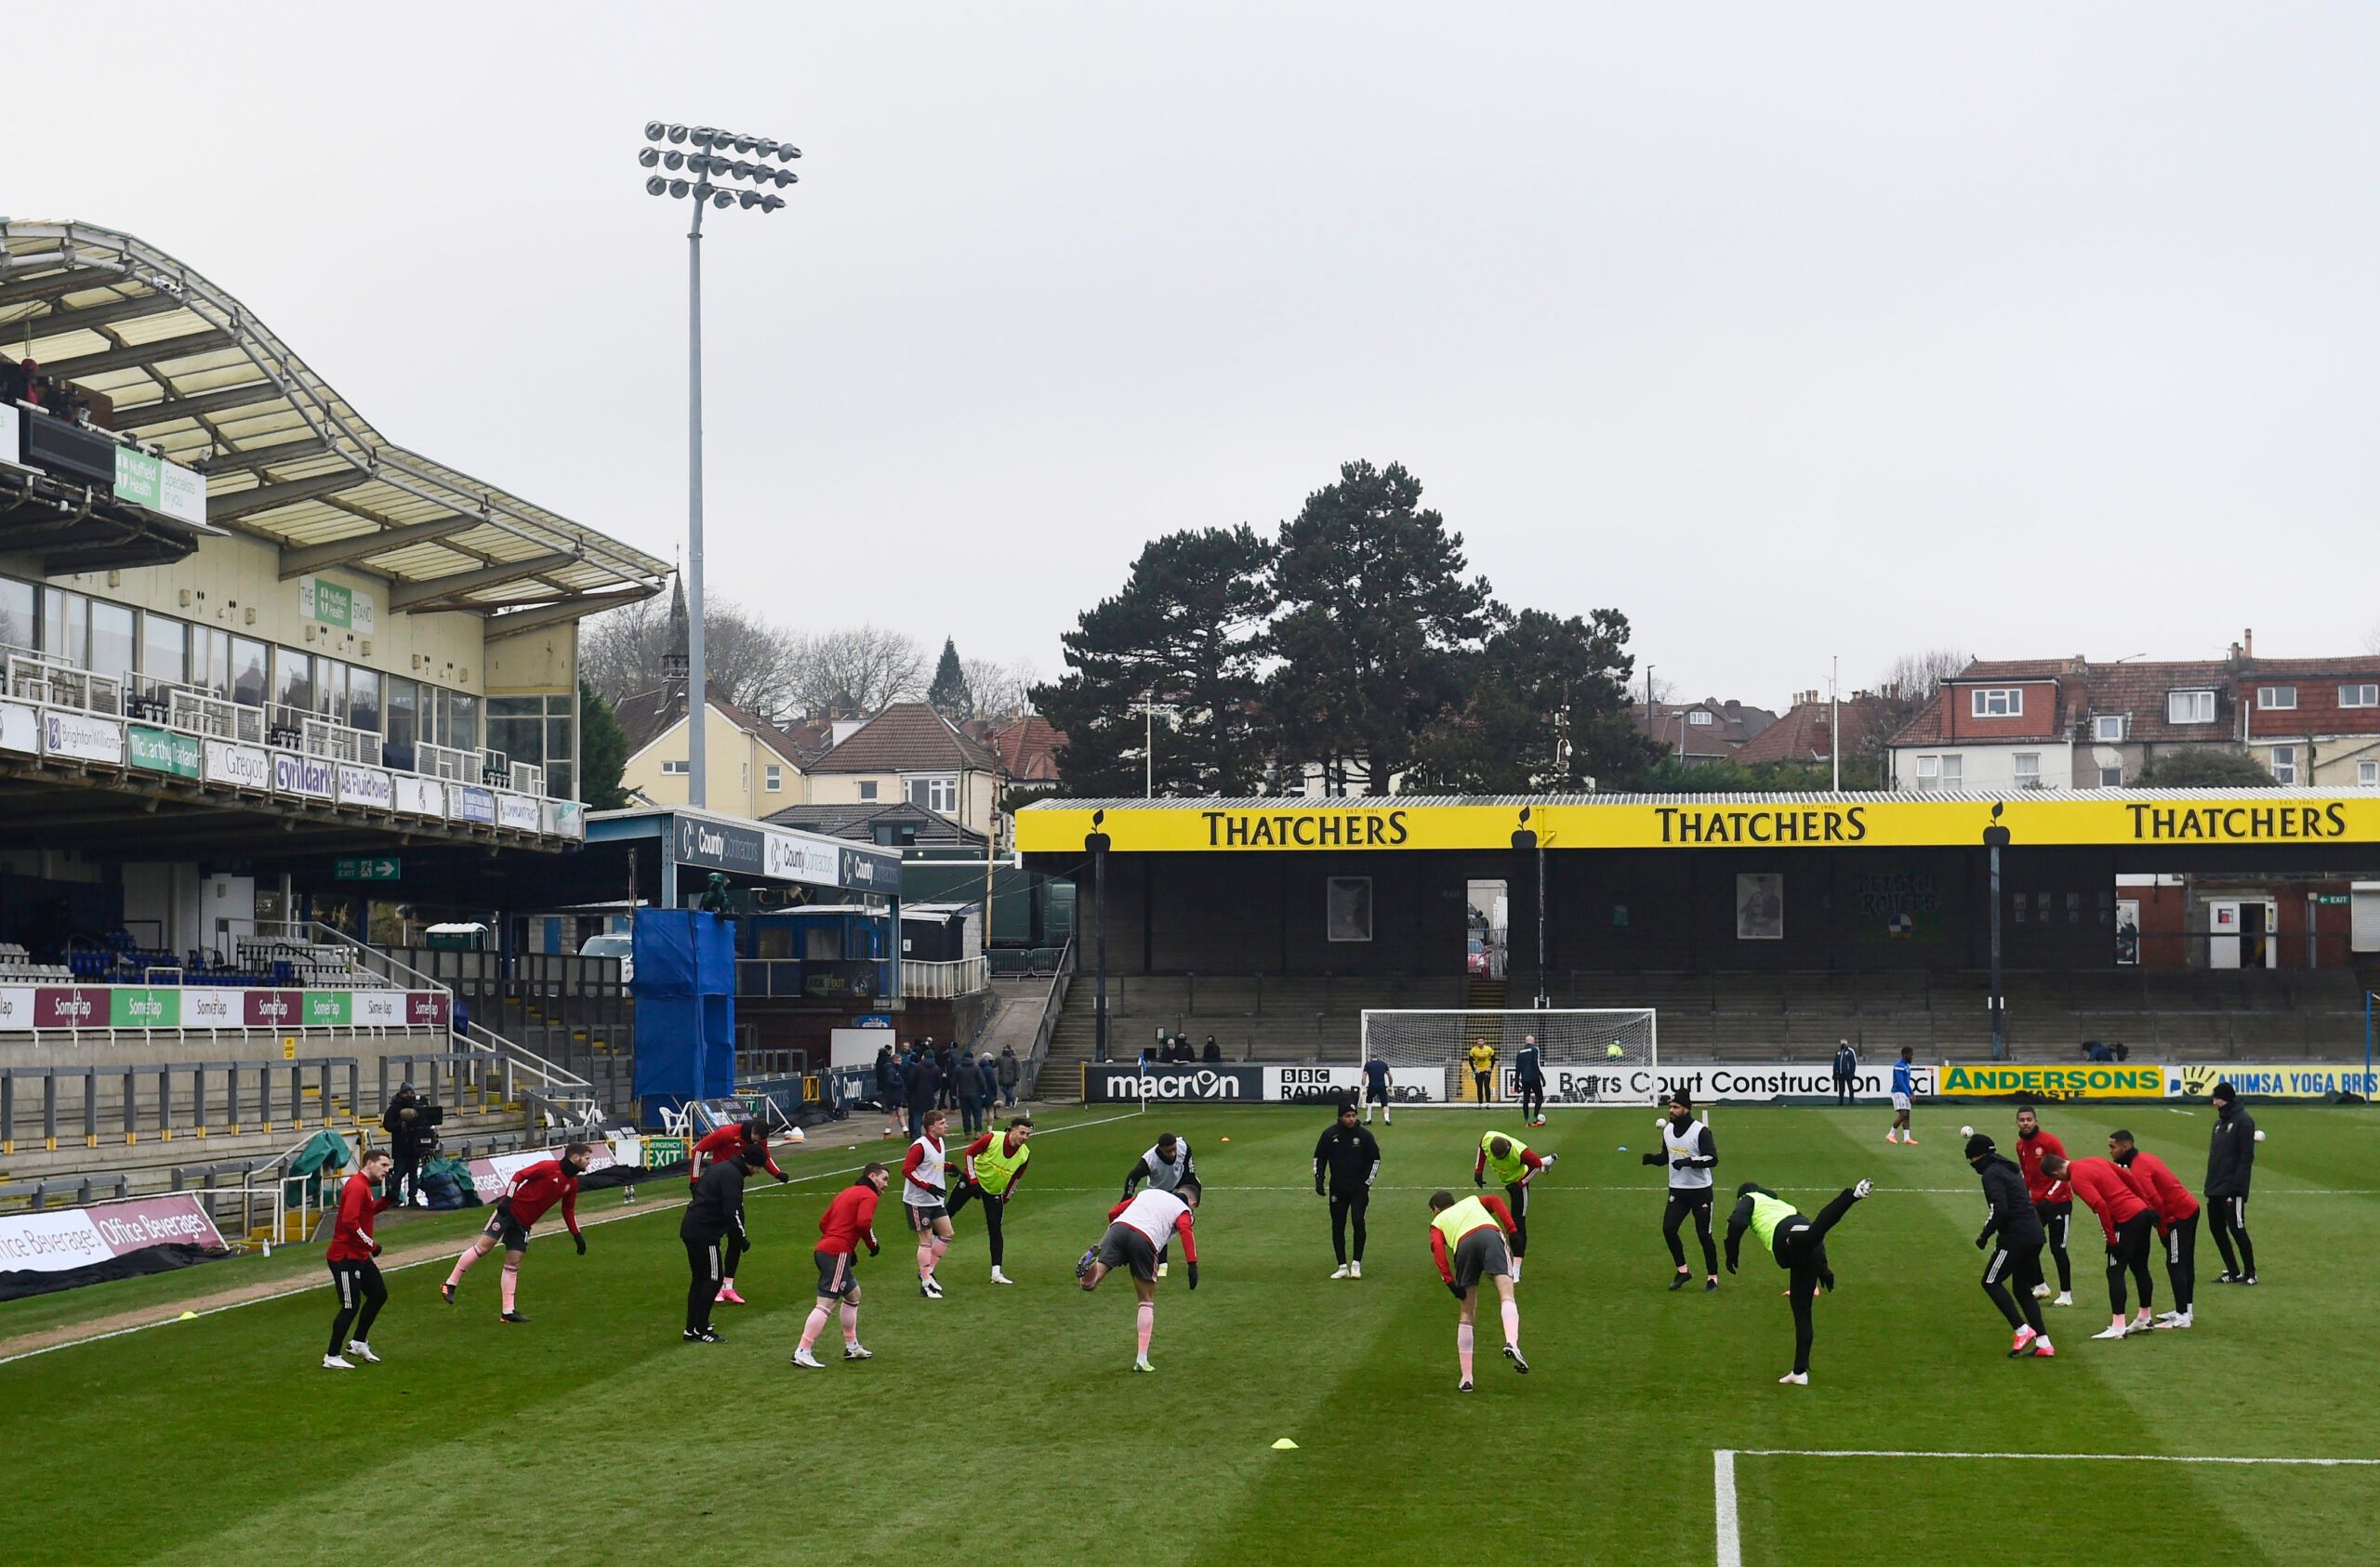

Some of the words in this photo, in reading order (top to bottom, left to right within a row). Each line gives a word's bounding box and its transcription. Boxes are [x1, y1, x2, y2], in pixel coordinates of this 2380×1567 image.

[130, 475, 152, 498] Health
[301, 586, 313, 606] THE
[353, 602, 372, 623] STAND
[225, 747, 263, 785] Gregor
[1201, 810, 1408, 847] THATCHERS
[1655, 807, 1867, 844] THATCHERS
[2126, 802, 2346, 839] THATCHERS
[338, 869, 355, 877] EXIT
[2330, 896, 2347, 904] EXIT
[313, 999, 340, 1020] Somerap
[368, 1000, 392, 1017] Somelap
[415, 1000, 439, 1018] Somerap
[1281, 1069, 1330, 1084] BBC
[1630, 1071, 1703, 1094] Court
[1711, 1071, 1882, 1094] Construcon
[1944, 1067, 2160, 1090] ANDERSONS
[2217, 1073, 2284, 1094] AHIMSA
[2290, 1073, 2335, 1094] YOGA
[2340, 1073, 2380, 1095] BRIS
[642, 1150, 681, 1167] EXIT
[99, 1217, 147, 1246] Office
[139, 1211, 208, 1240] Beverages
[23, 1228, 102, 1257] Beverages
